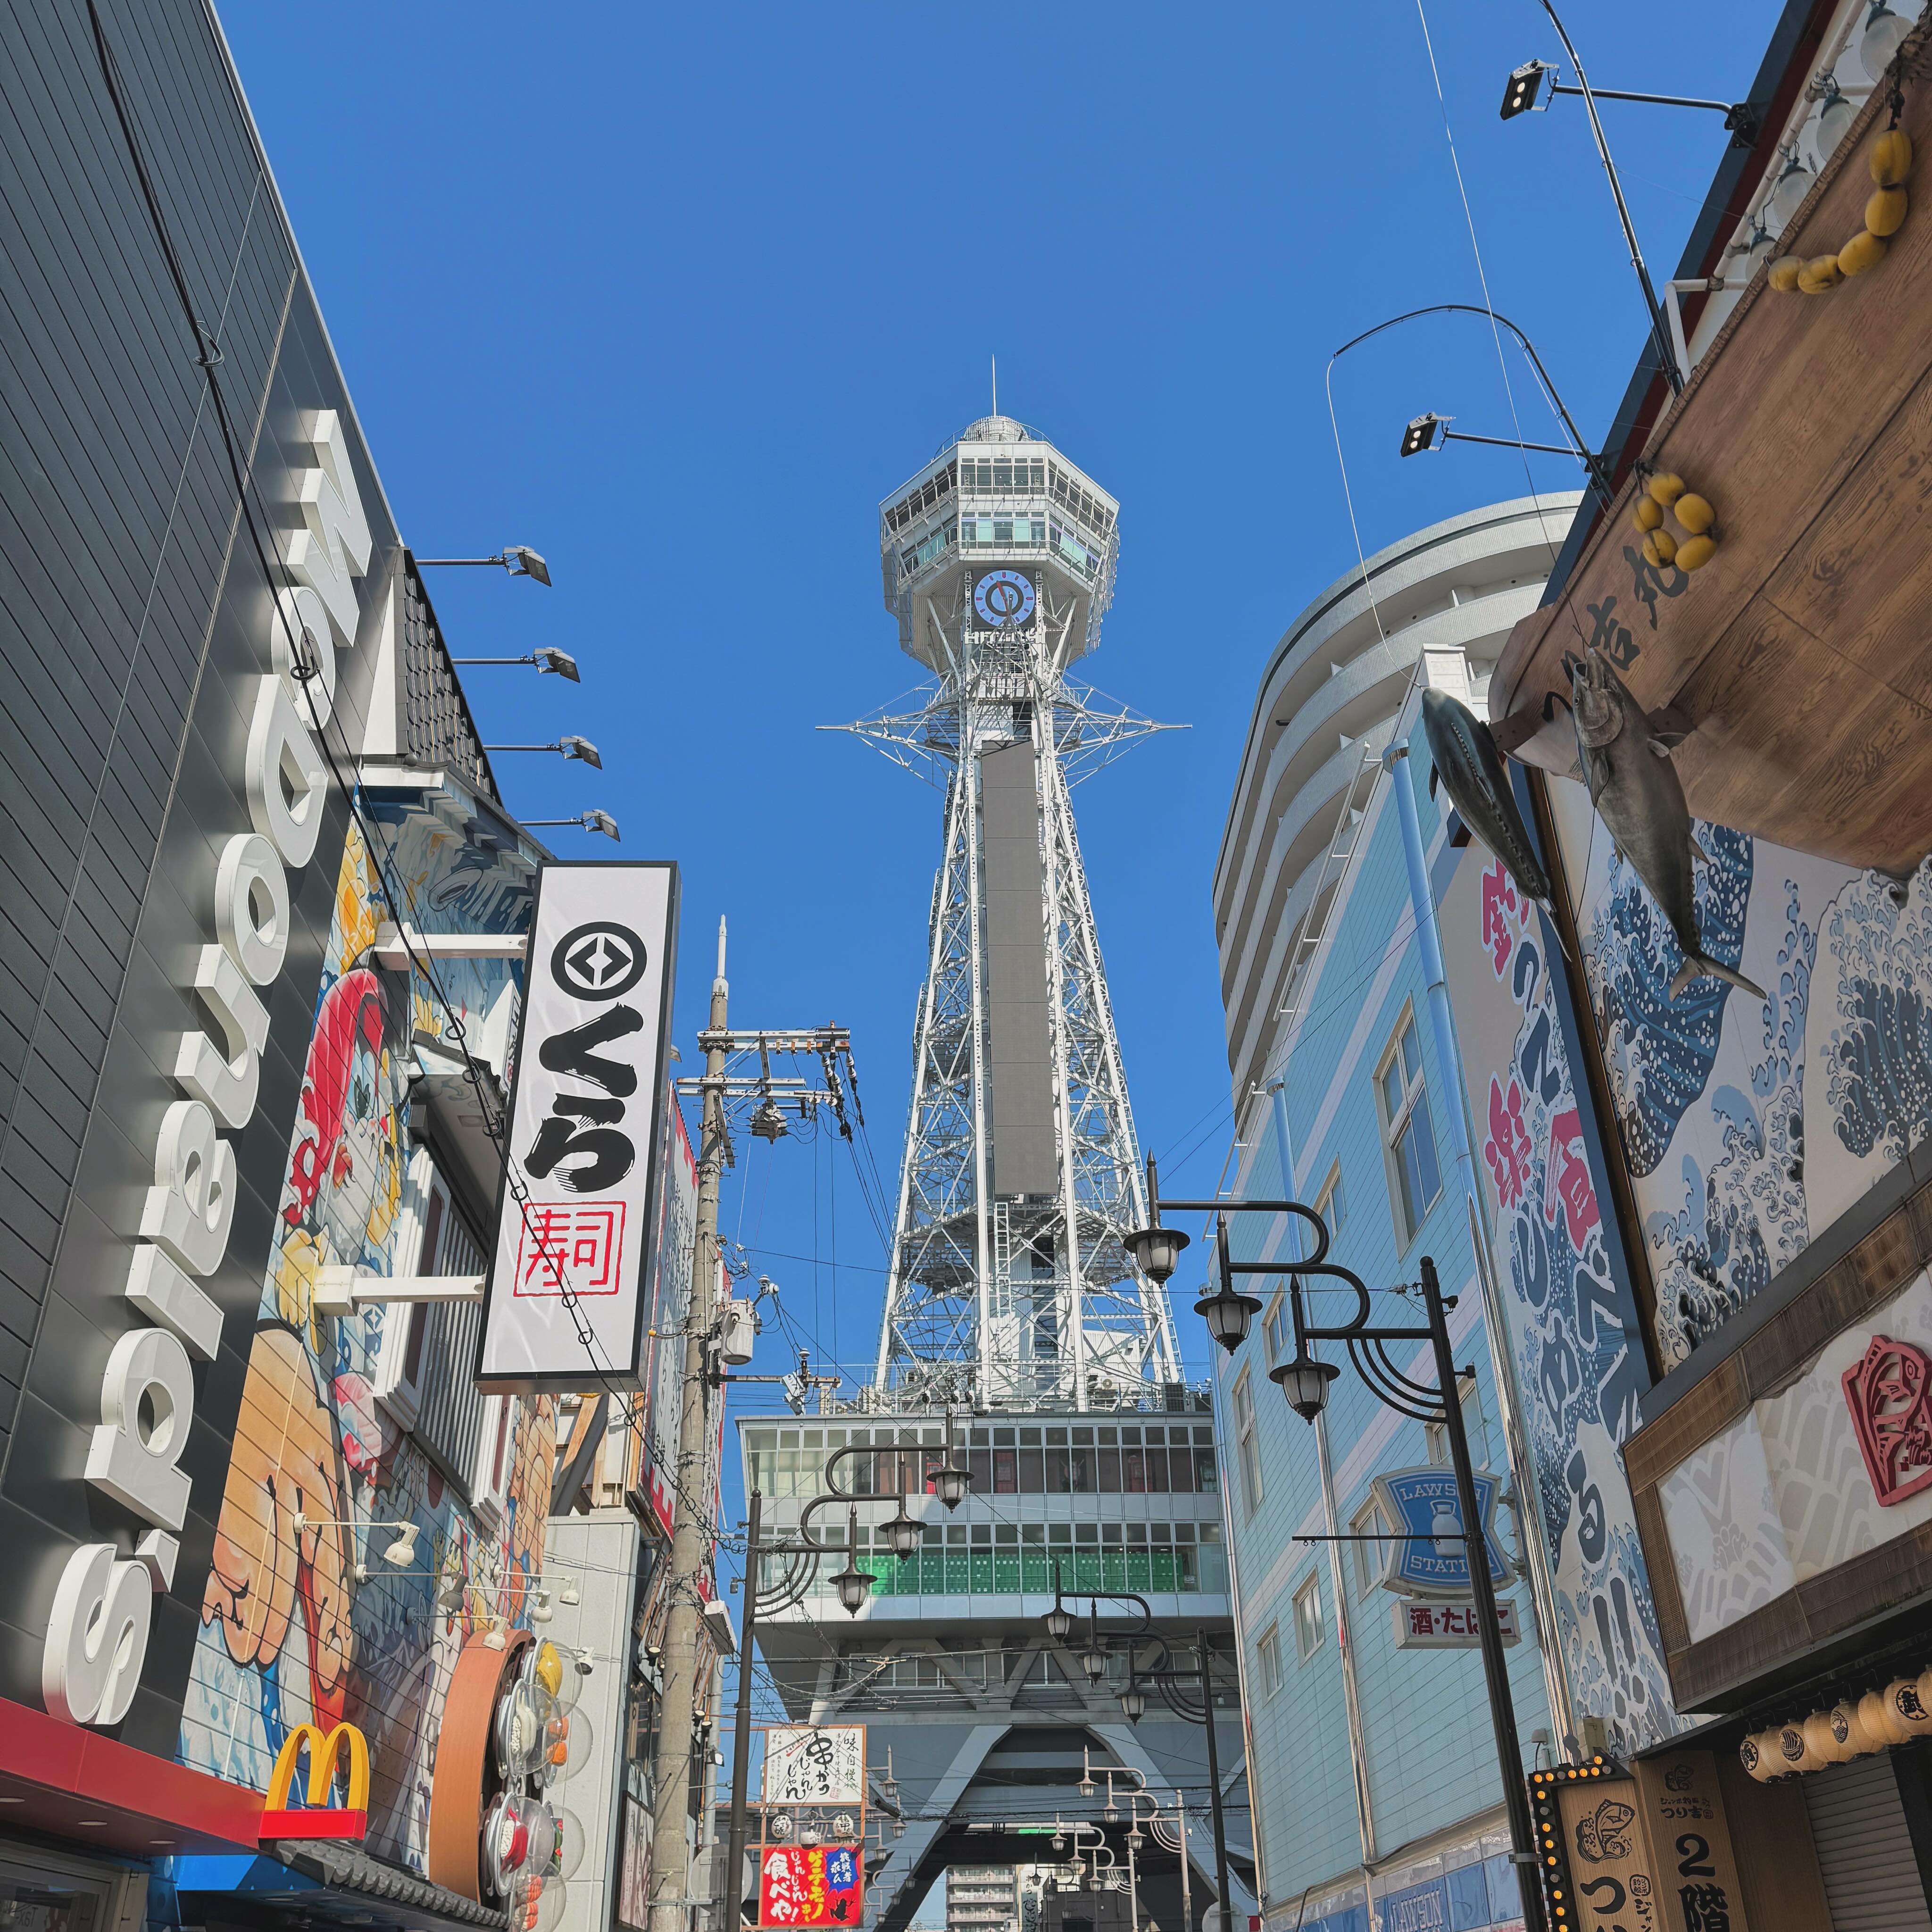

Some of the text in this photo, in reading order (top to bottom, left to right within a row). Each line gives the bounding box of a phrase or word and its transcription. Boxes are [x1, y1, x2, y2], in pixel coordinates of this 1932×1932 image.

[42, 409, 372, 1724] McDonald's
[524, 1002, 643, 1193] くら
[525, 1208, 615, 1287] 寿司
[1400, 1483, 1482, 1501] LAWSN
[1411, 1555, 1494, 1573] STATI
[806, 1732, 833, 1795] 串かつ
[808, 1850, 825, 1919] ゲテモノ
